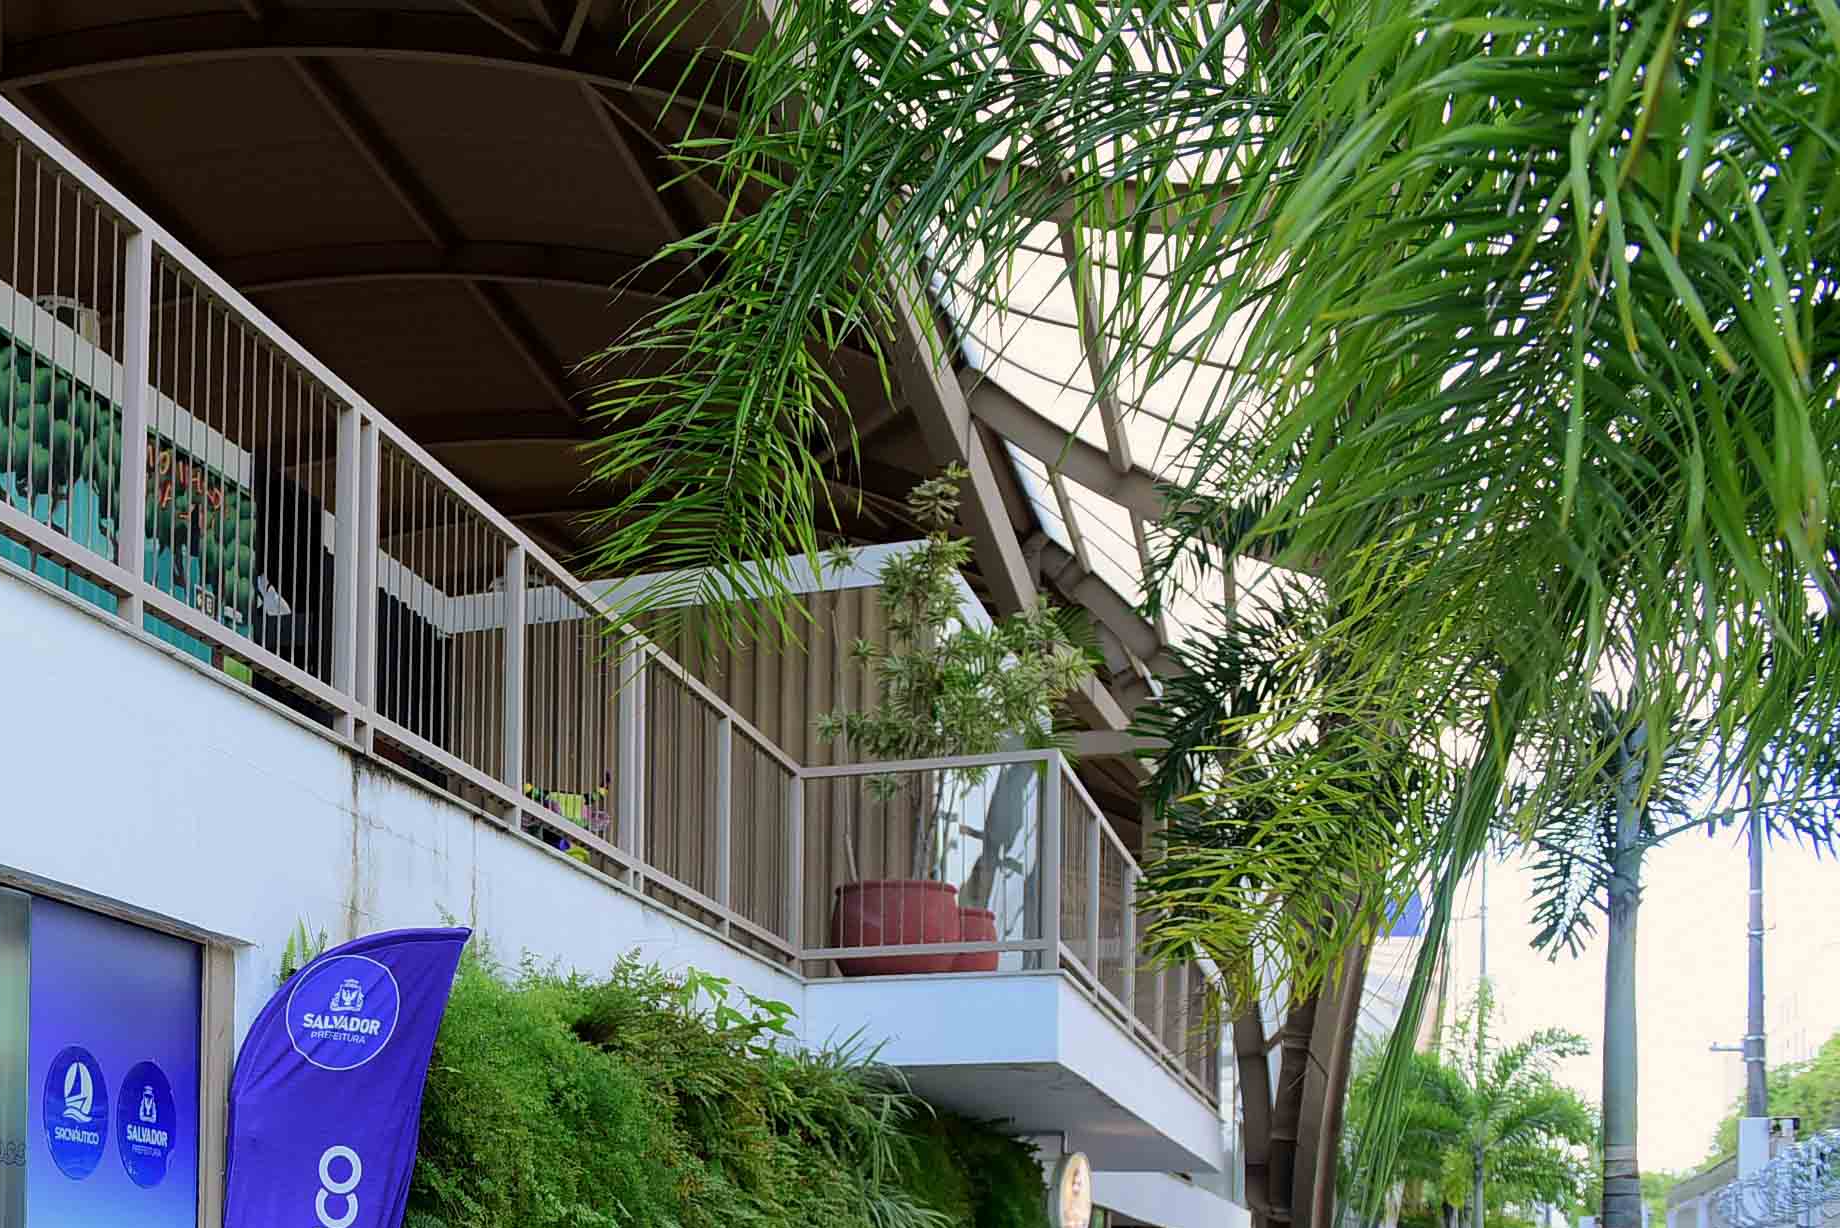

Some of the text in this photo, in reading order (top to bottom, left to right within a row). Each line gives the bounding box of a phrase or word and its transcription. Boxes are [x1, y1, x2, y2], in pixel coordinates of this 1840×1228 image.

[302, 1012, 381, 1036] SALVADOR
[310, 1030, 366, 1044] PREFEITURA
[126, 1123, 168, 1148] SALVADOR
